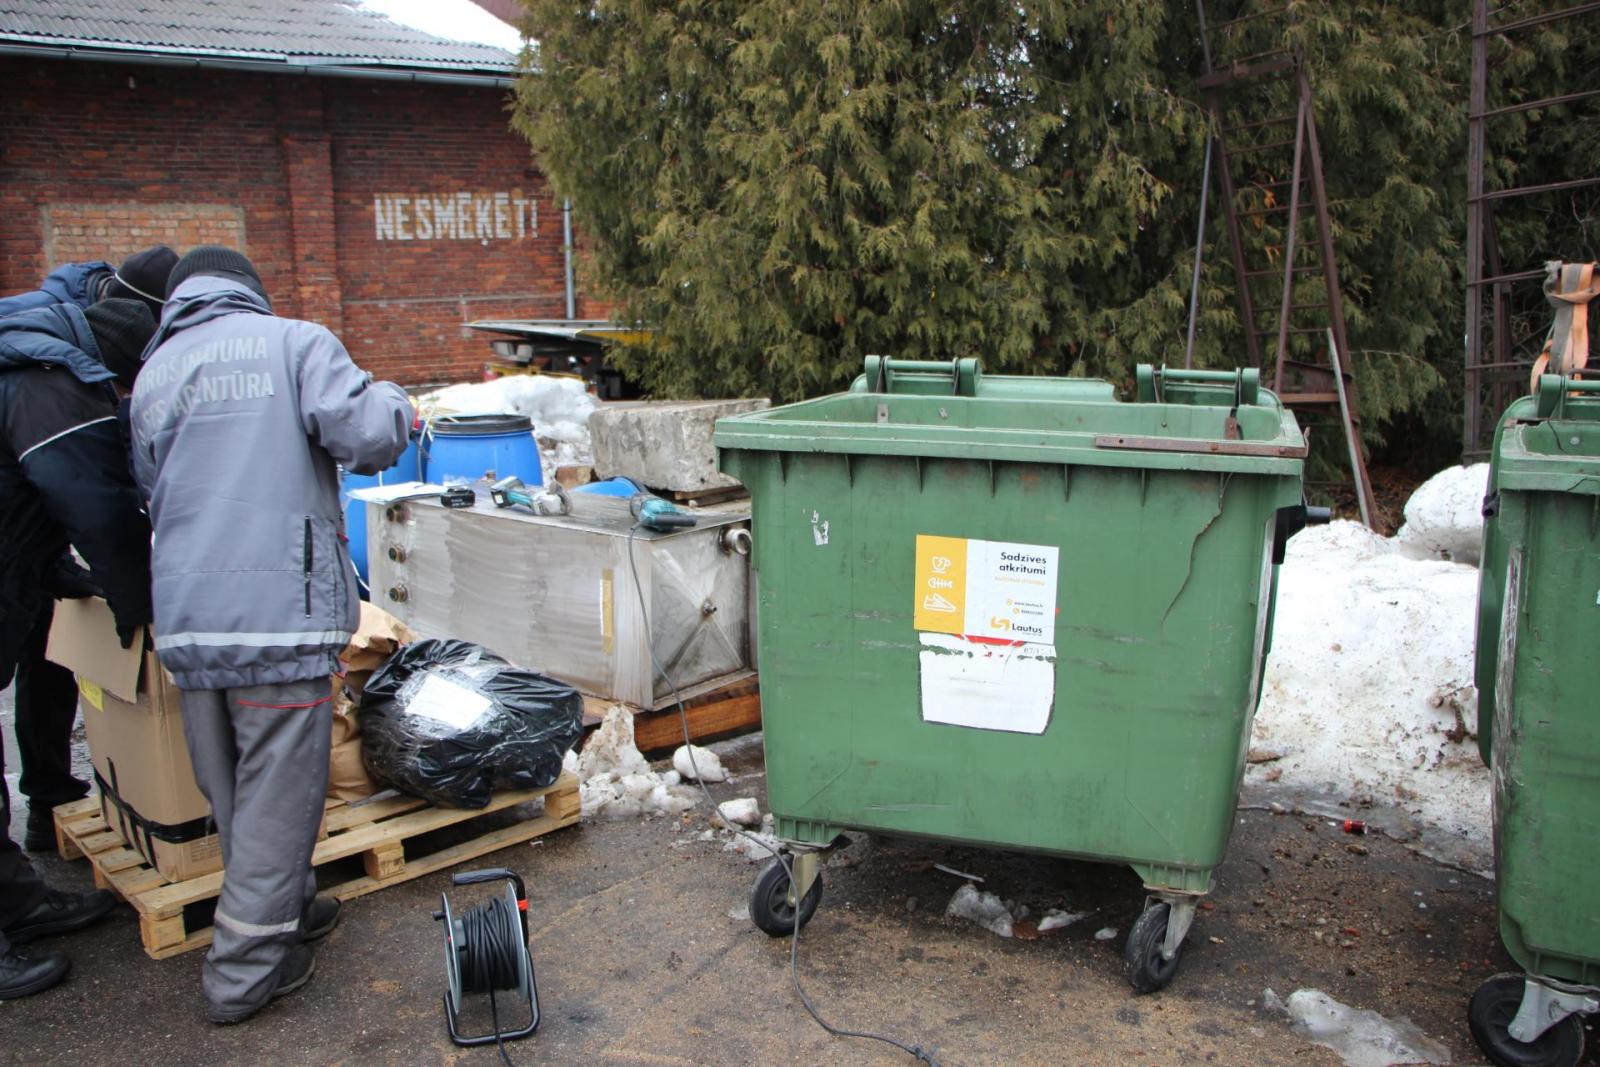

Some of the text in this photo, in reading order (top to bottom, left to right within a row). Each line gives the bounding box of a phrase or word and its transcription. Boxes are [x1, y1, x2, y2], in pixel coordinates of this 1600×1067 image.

[374, 192, 538, 246] NESMĒĶĒT!
[1000, 551, 1047, 564] Sadzīves
[999, 563, 1046, 575] atkritumi
[1012, 623, 1043, 633] Lautus
